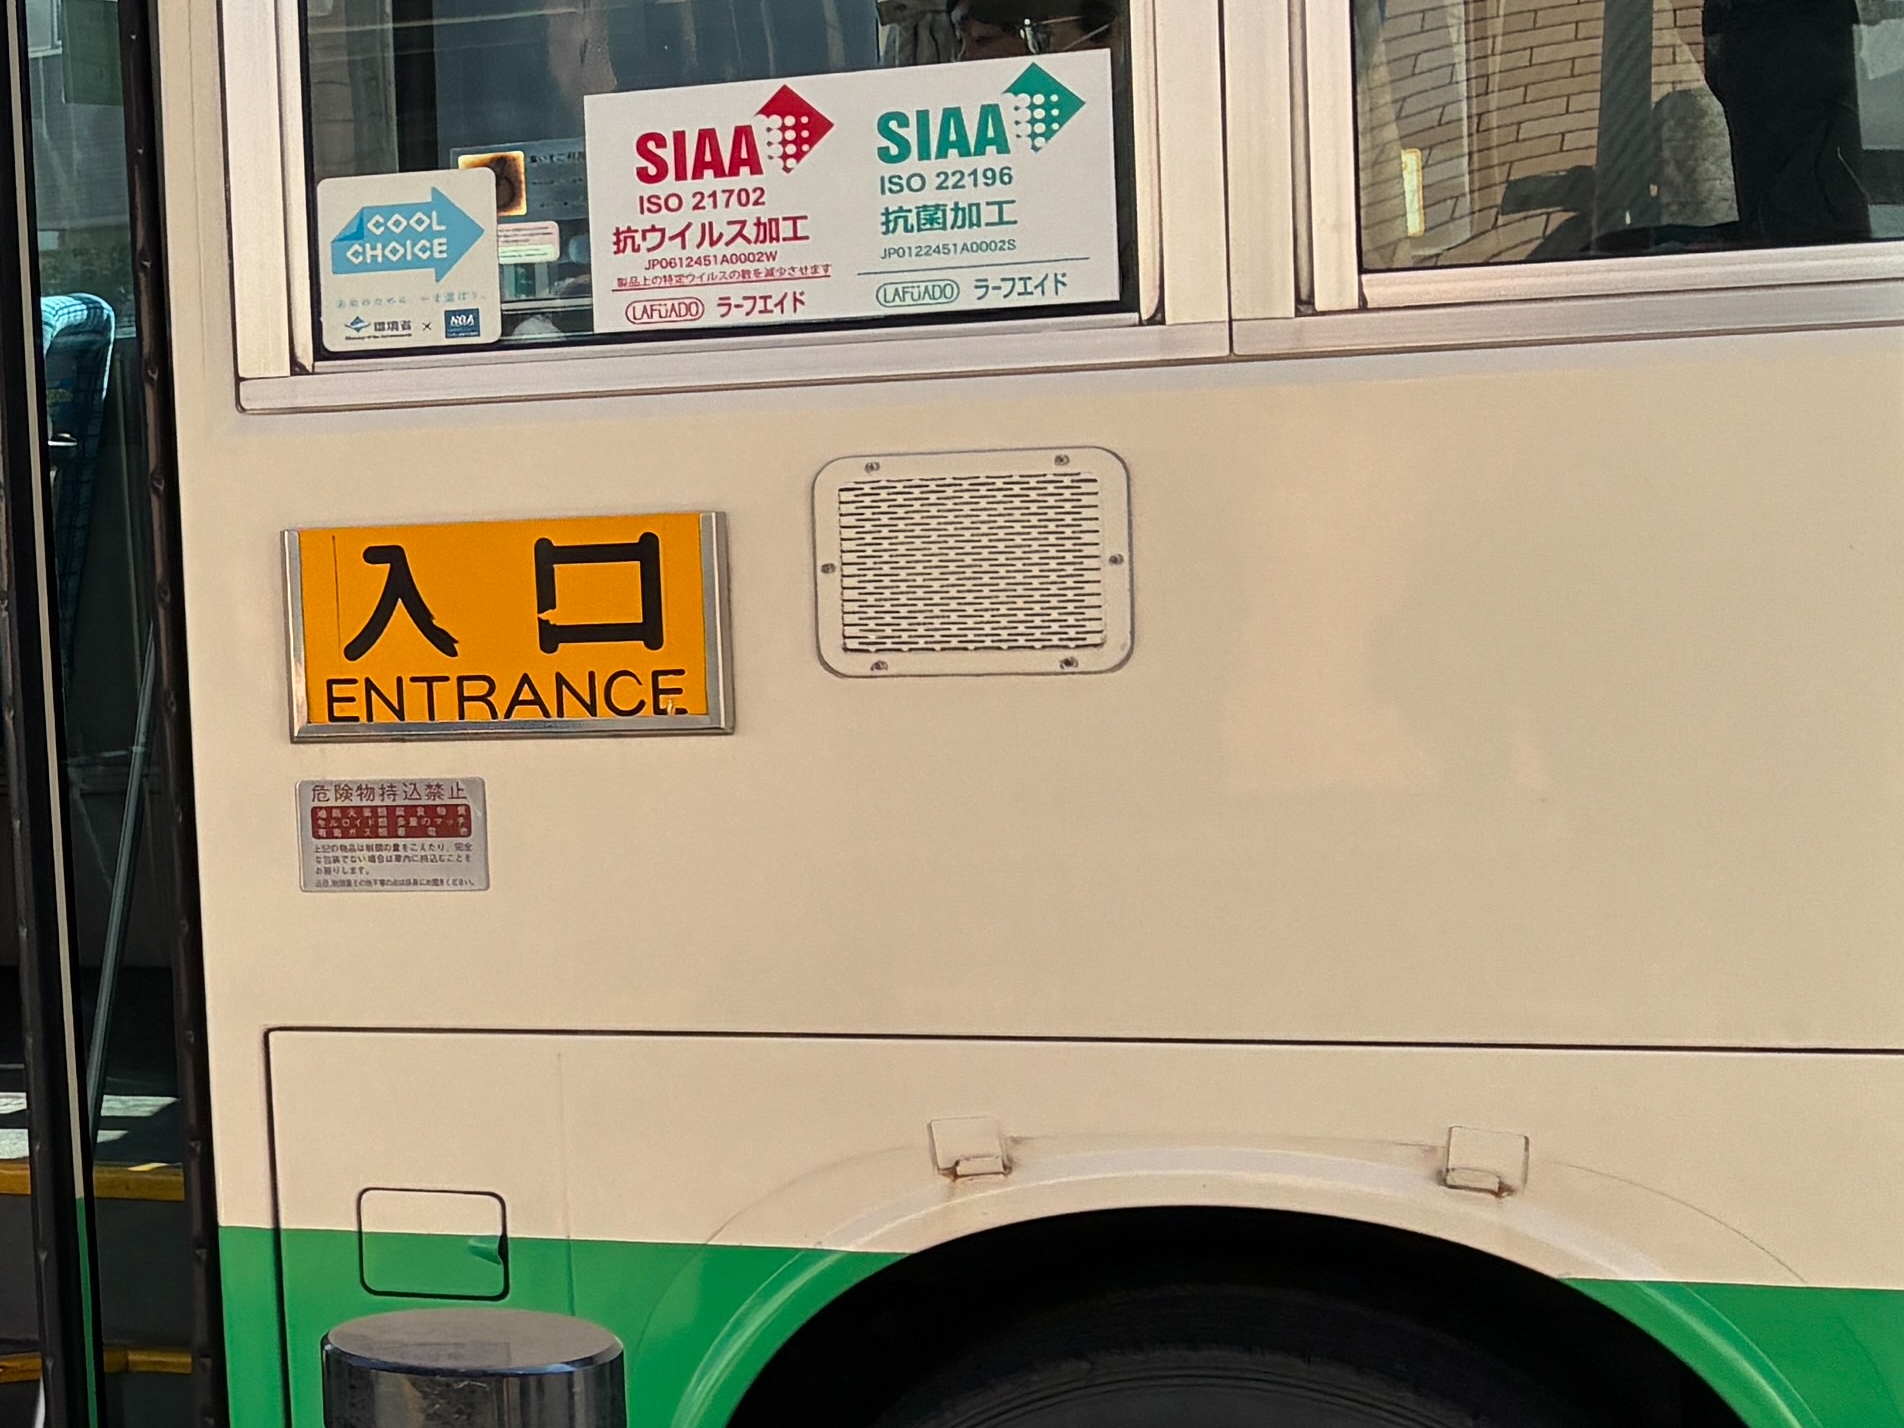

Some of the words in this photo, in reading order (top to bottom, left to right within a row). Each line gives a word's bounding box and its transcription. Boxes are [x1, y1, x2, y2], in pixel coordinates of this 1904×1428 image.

[877, 103, 1011, 165] SIAA
[635, 125, 764, 184] SIAA
[880, 173, 927, 195] ISO
[935, 166, 1014, 191] 22196
[639, 193, 684, 215] ISO
[691, 186, 766, 212] 21702
[367, 210, 446, 236] COOL
[880, 200, 1018, 236] 抗菌加工
[613, 215, 810, 255] 抗ウイルス加工
[880, 239, 1017, 259] JP0122451A0002S
[346, 238, 448, 264] CHOICE
[644, 251, 778, 270] JP0612451A0002W
[973, 272, 1068, 300] ラーフエイド
[716, 290, 806, 318] ラーフエイド
[343, 532, 664, 662] 入口
[326, 669, 689, 723] ENTRANCE
[311, 781, 468, 803] 危険物持込禁止
